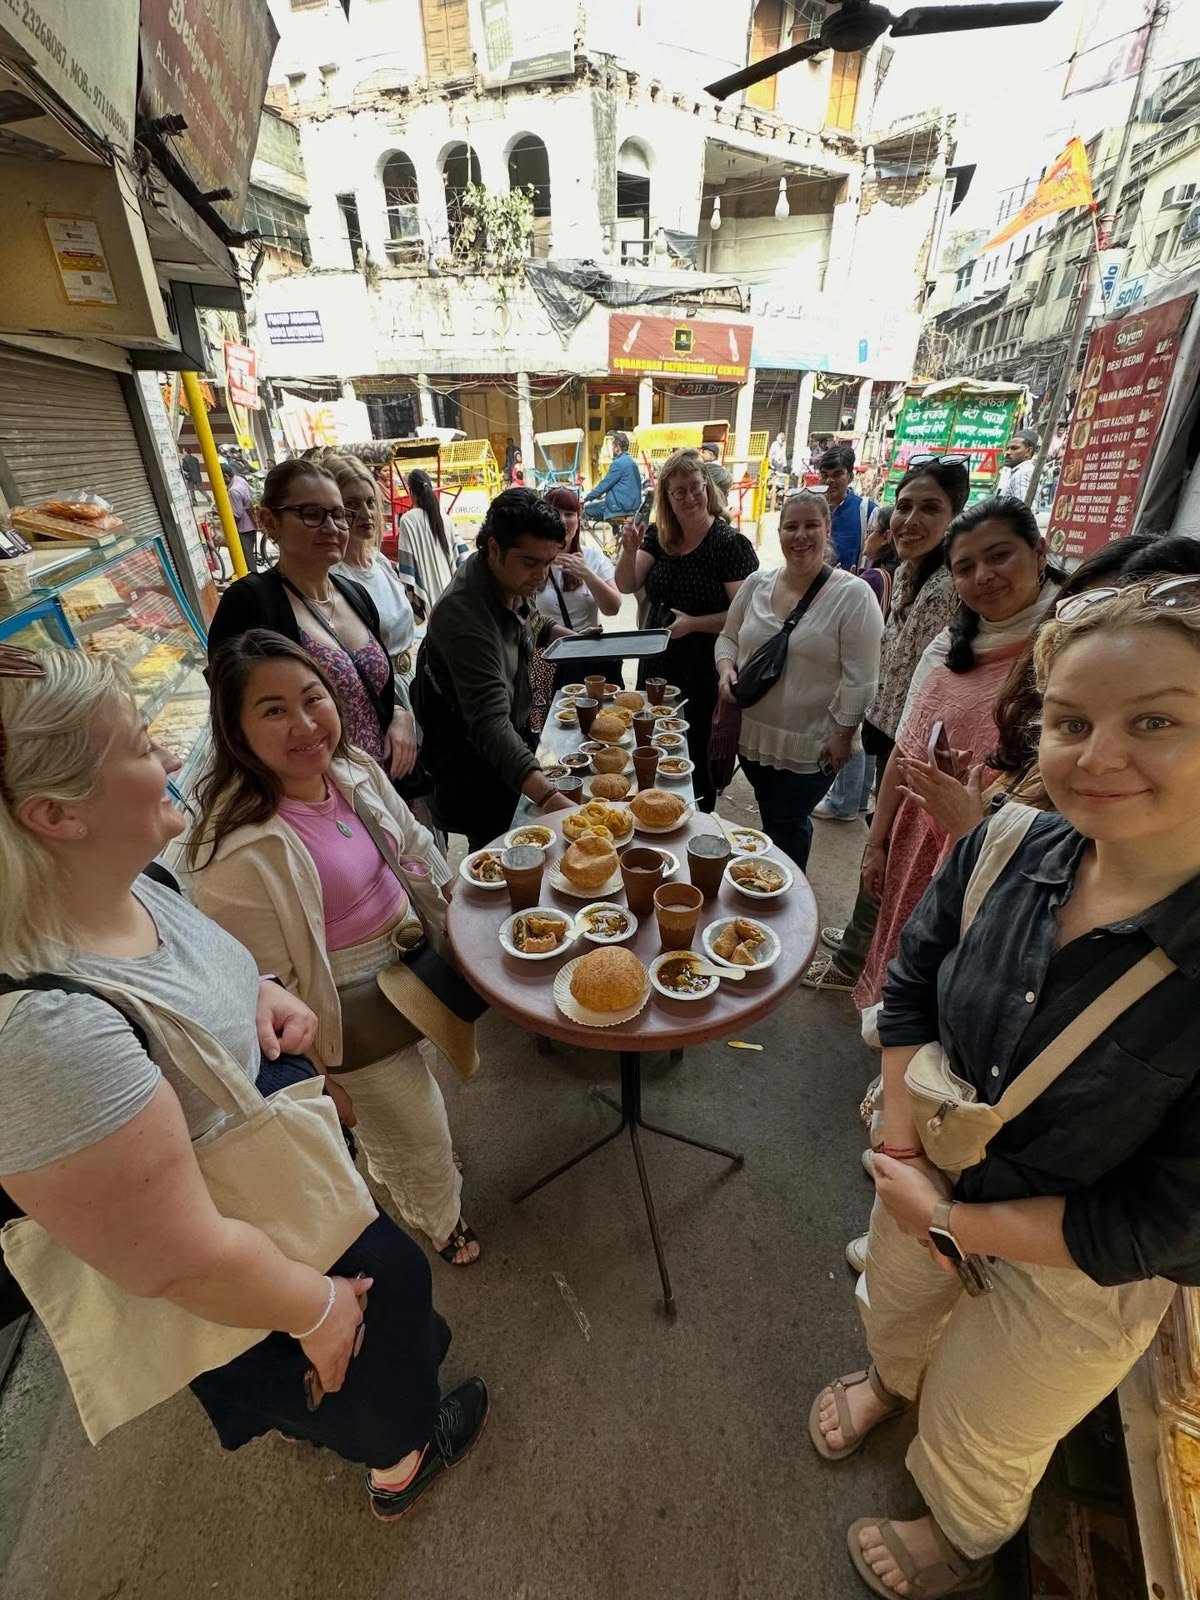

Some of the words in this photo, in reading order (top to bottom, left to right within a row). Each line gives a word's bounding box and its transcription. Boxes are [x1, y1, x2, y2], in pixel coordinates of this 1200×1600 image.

[156, 40, 172, 76] ALL
[1116, 281, 1143, 307] solo
[1116, 329, 1144, 346] Shyam
[1106, 359, 1122, 372] DESI
[1117, 385, 1144, 400] NAGORI
[1110, 413, 1135, 427] KACHORI
[1101, 431, 1131, 444] KACHORI
[1101, 450, 1125, 460] SAMOSA
[1100, 460, 1122, 470] SAMOSA
[1099, 471, 1120, 480] SAMOSA
[1096, 481, 1117, 490] SAMOSA
